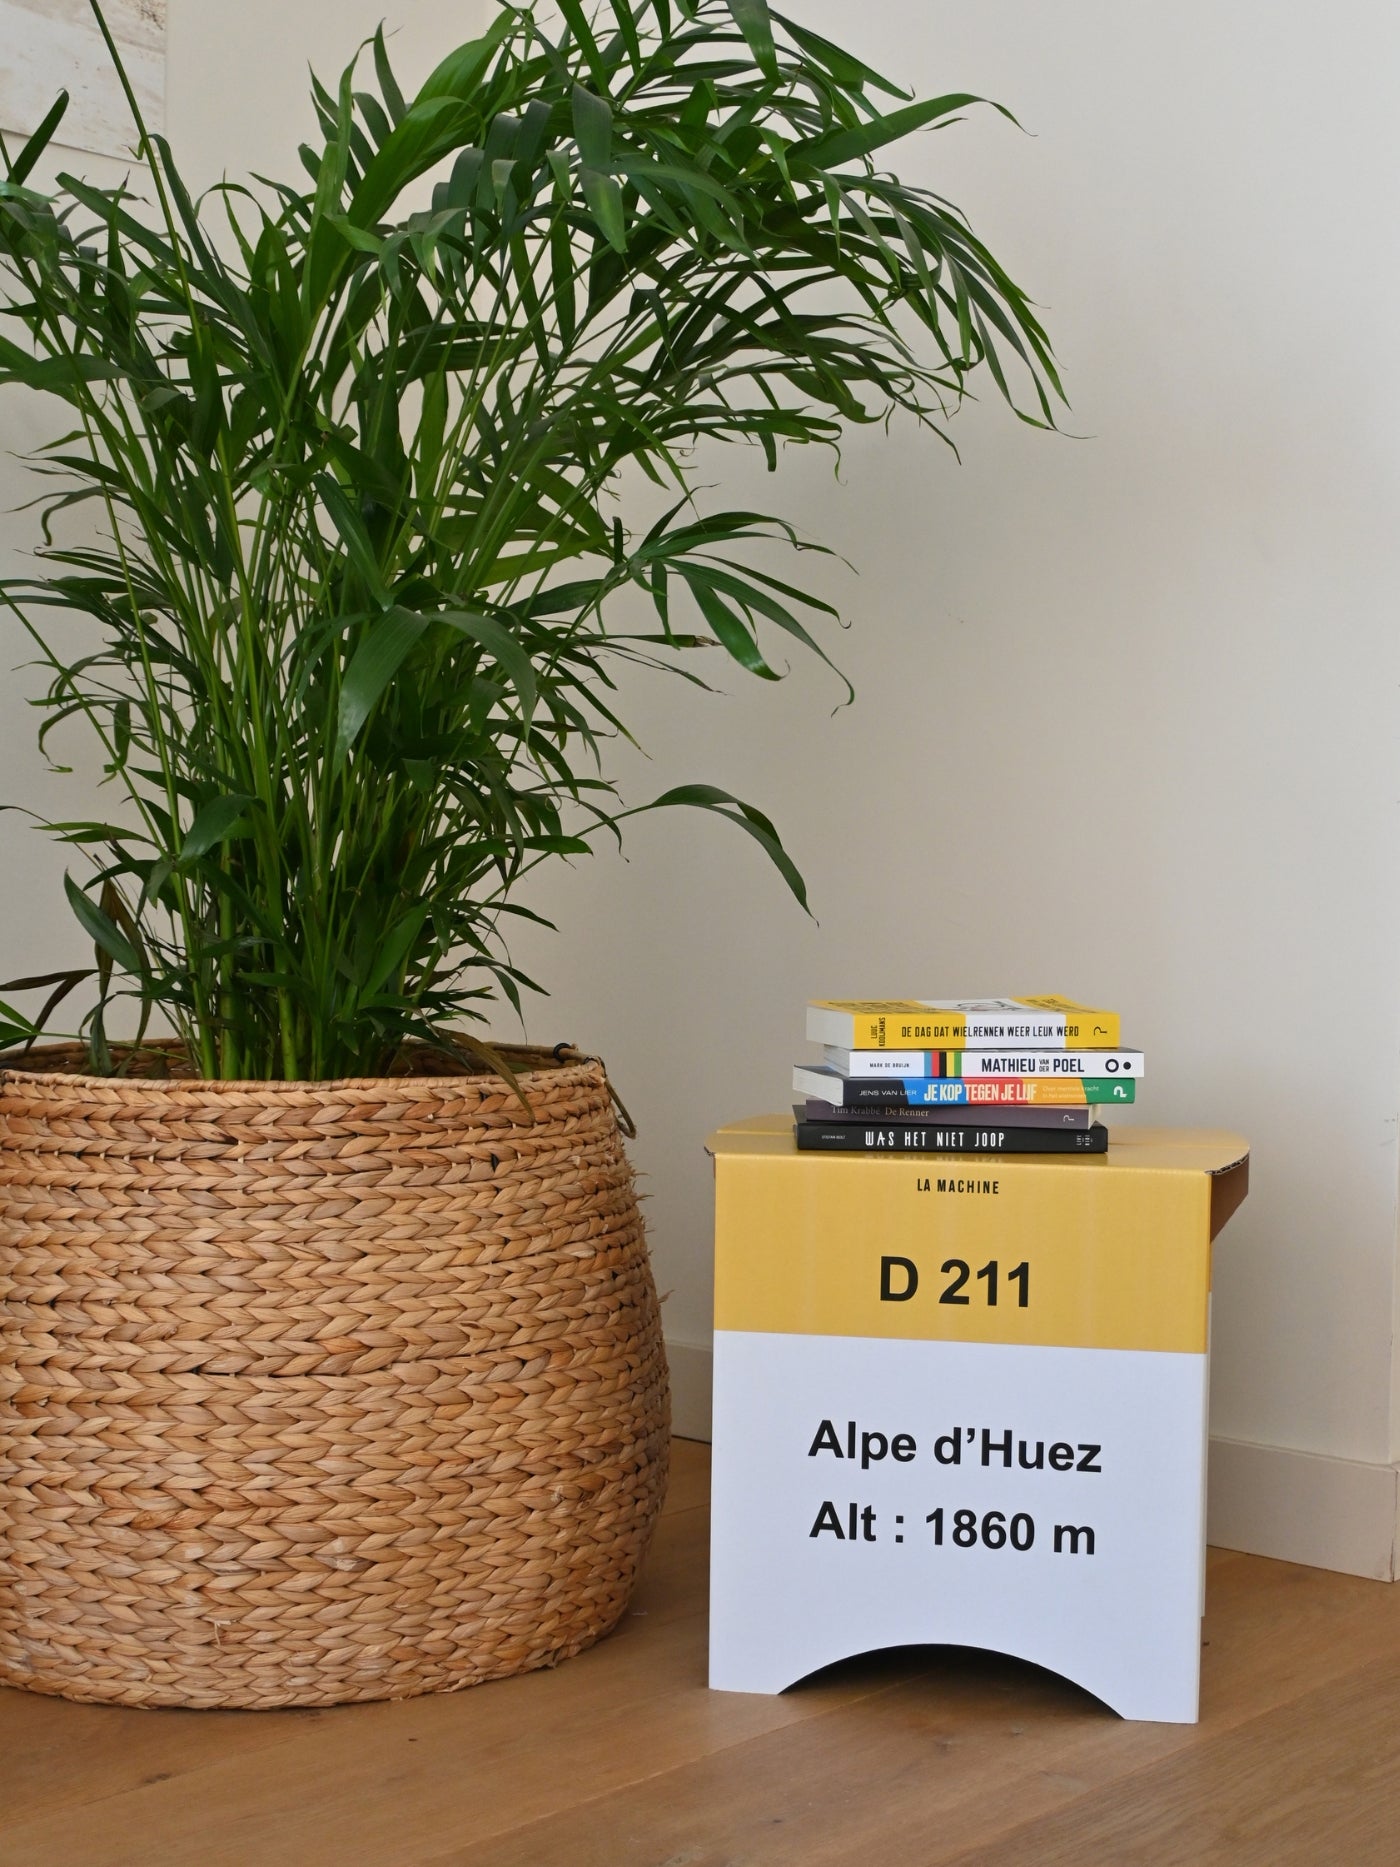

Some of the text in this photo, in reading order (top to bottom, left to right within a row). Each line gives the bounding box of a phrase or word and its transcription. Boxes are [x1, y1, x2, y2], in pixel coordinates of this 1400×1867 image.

[901, 1026, 1079, 1038] DE DAG DAT WIELRENNEN WEER LEUK WERD
[981, 1058, 1036, 1073] MATHIEU
[1053, 1058, 1085, 1073] POEL
[924, 1084, 1037, 1101] JE KOP TEGEN JE LIJF
[832, 1106, 848, 1114] Tim
[885, 1107, 929, 1117] De Renner
[865, 1131, 1005, 1148] WAS HET NIET JOOP
[917, 1178, 999, 1194] LA MACHINE
[880, 1255, 1030, 1308] D 211
[808, 1419, 917, 1470] Alpe
[809, 1501, 1095, 1555] Alt : 1860 m
